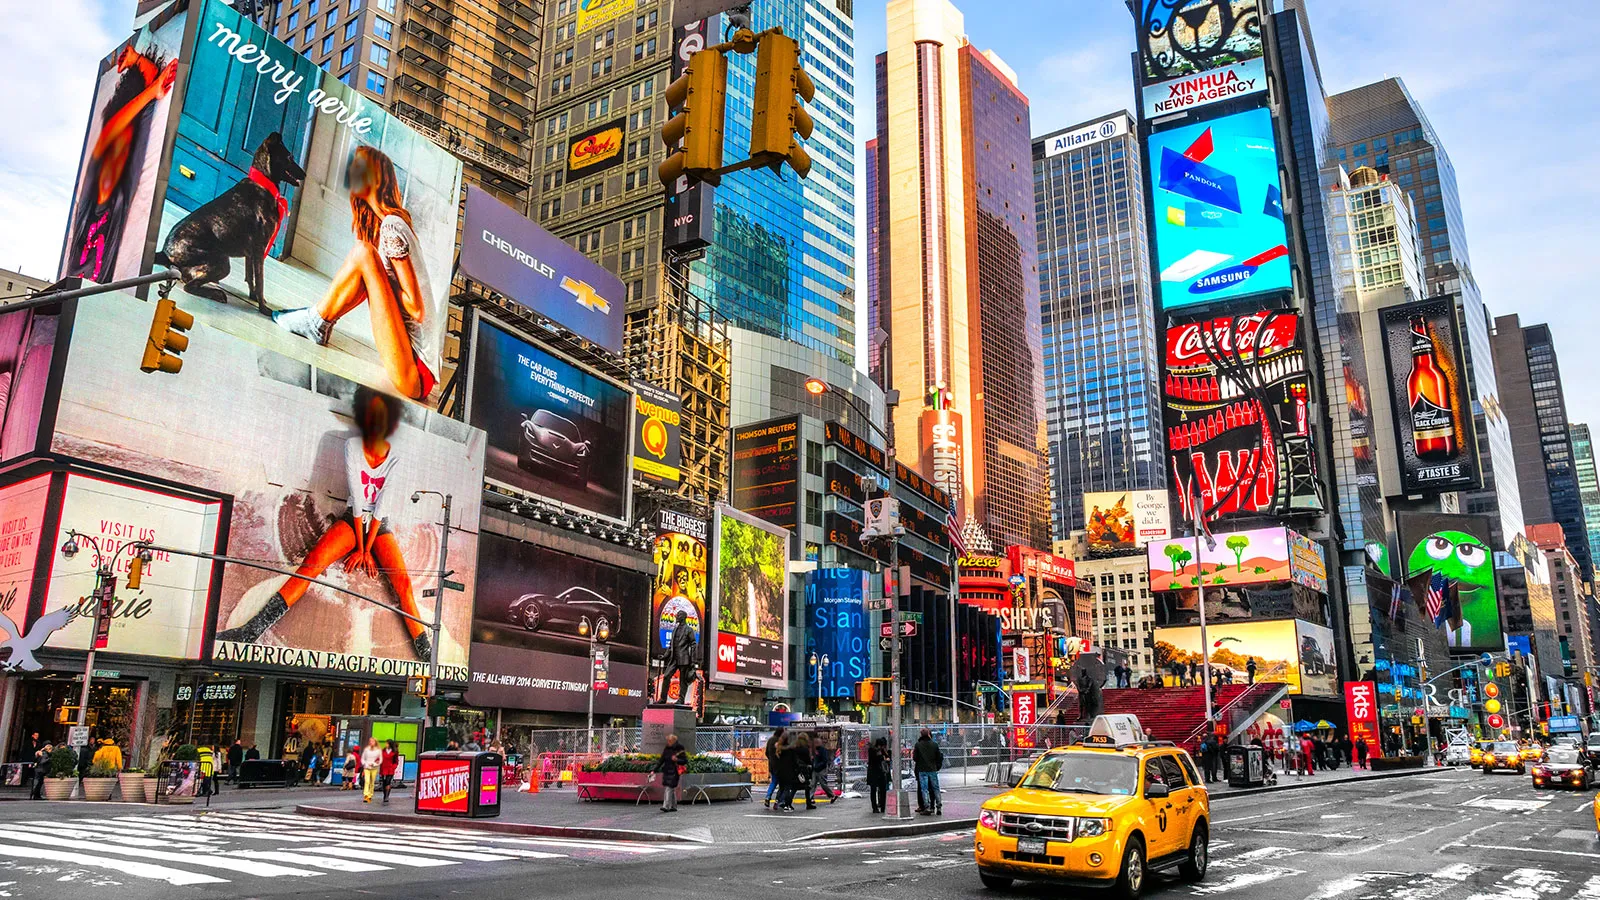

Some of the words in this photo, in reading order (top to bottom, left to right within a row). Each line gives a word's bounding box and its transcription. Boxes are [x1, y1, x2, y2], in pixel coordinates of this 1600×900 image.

[207, 22, 304, 105] merry
[307, 87, 371, 134] aerie
[1169, 69, 1239, 98] XINHUA
[1155, 94, 1195, 113] NEWS
[1197, 79, 1256, 104] AGENCY
[1054, 131, 1097, 151] Allianz
[1184, 171, 1222, 191] PANDORA
[674, 213, 693, 227] NYC
[482, 229, 555, 280] CHEVROLET
[1197, 270, 1250, 288] SAMSUNG
[518, 354, 530, 367] THE
[530, 360, 542, 373] CAR
[542, 366, 557, 380] DOES
[530, 371, 565, 393] EVERYTHING
[565, 387, 595, 407] PERFECTLY
[636, 394, 680, 427] Avenue
[642, 417, 668, 460] Q
[736, 428, 767, 440] THOMSON
[768, 422, 797, 435] REUTERS
[1418, 467, 1450, 479] #TASTE
[1452, 465, 1460, 475] IS
[1146, 494, 1155, 503] By
[2, 518, 17, 535] VISIT
[18, 516, 27, 531] US
[101, 519, 135, 539] VISIT
[139, 527, 155, 543] US
[660, 509, 676, 525] THE
[677, 514, 707, 534] BIGGEST
[1142, 517, 1153, 525] did
[11, 536, 20, 550] ON
[21, 532, 33, 546] THE
[75, 534, 122, 555] INSIDE
[4, 552, 21, 567] LEVEL
[117, 559, 152, 577] LEL
[79, 589, 152, 619] arie
[824, 597, 844, 605] Morgan
[844, 597, 862, 606] Stanley
[874, 601, 880, 609] 46
[660, 611, 699, 628] MOWN
[217, 641, 321, 668] AMERICAN
[326, 652, 378, 673] EAGLE
[381, 659, 468, 682] OUTFITTERS
[718, 643, 735, 663] CNN
[472, 672, 486, 683] THE
[486, 673, 516, 686] ALL-NEW
[517, 677, 531, 687] 2014
[532, 678, 561, 690] CORVETTE
[562, 681, 588, 692] STINGRAY
[204, 685, 237, 700] JEANS
[1352, 685, 1370, 718] tkts
[1018, 695, 1032, 724] tkts
[419, 775, 447, 800] JERSEY
[448, 772, 470, 795] BOYS
